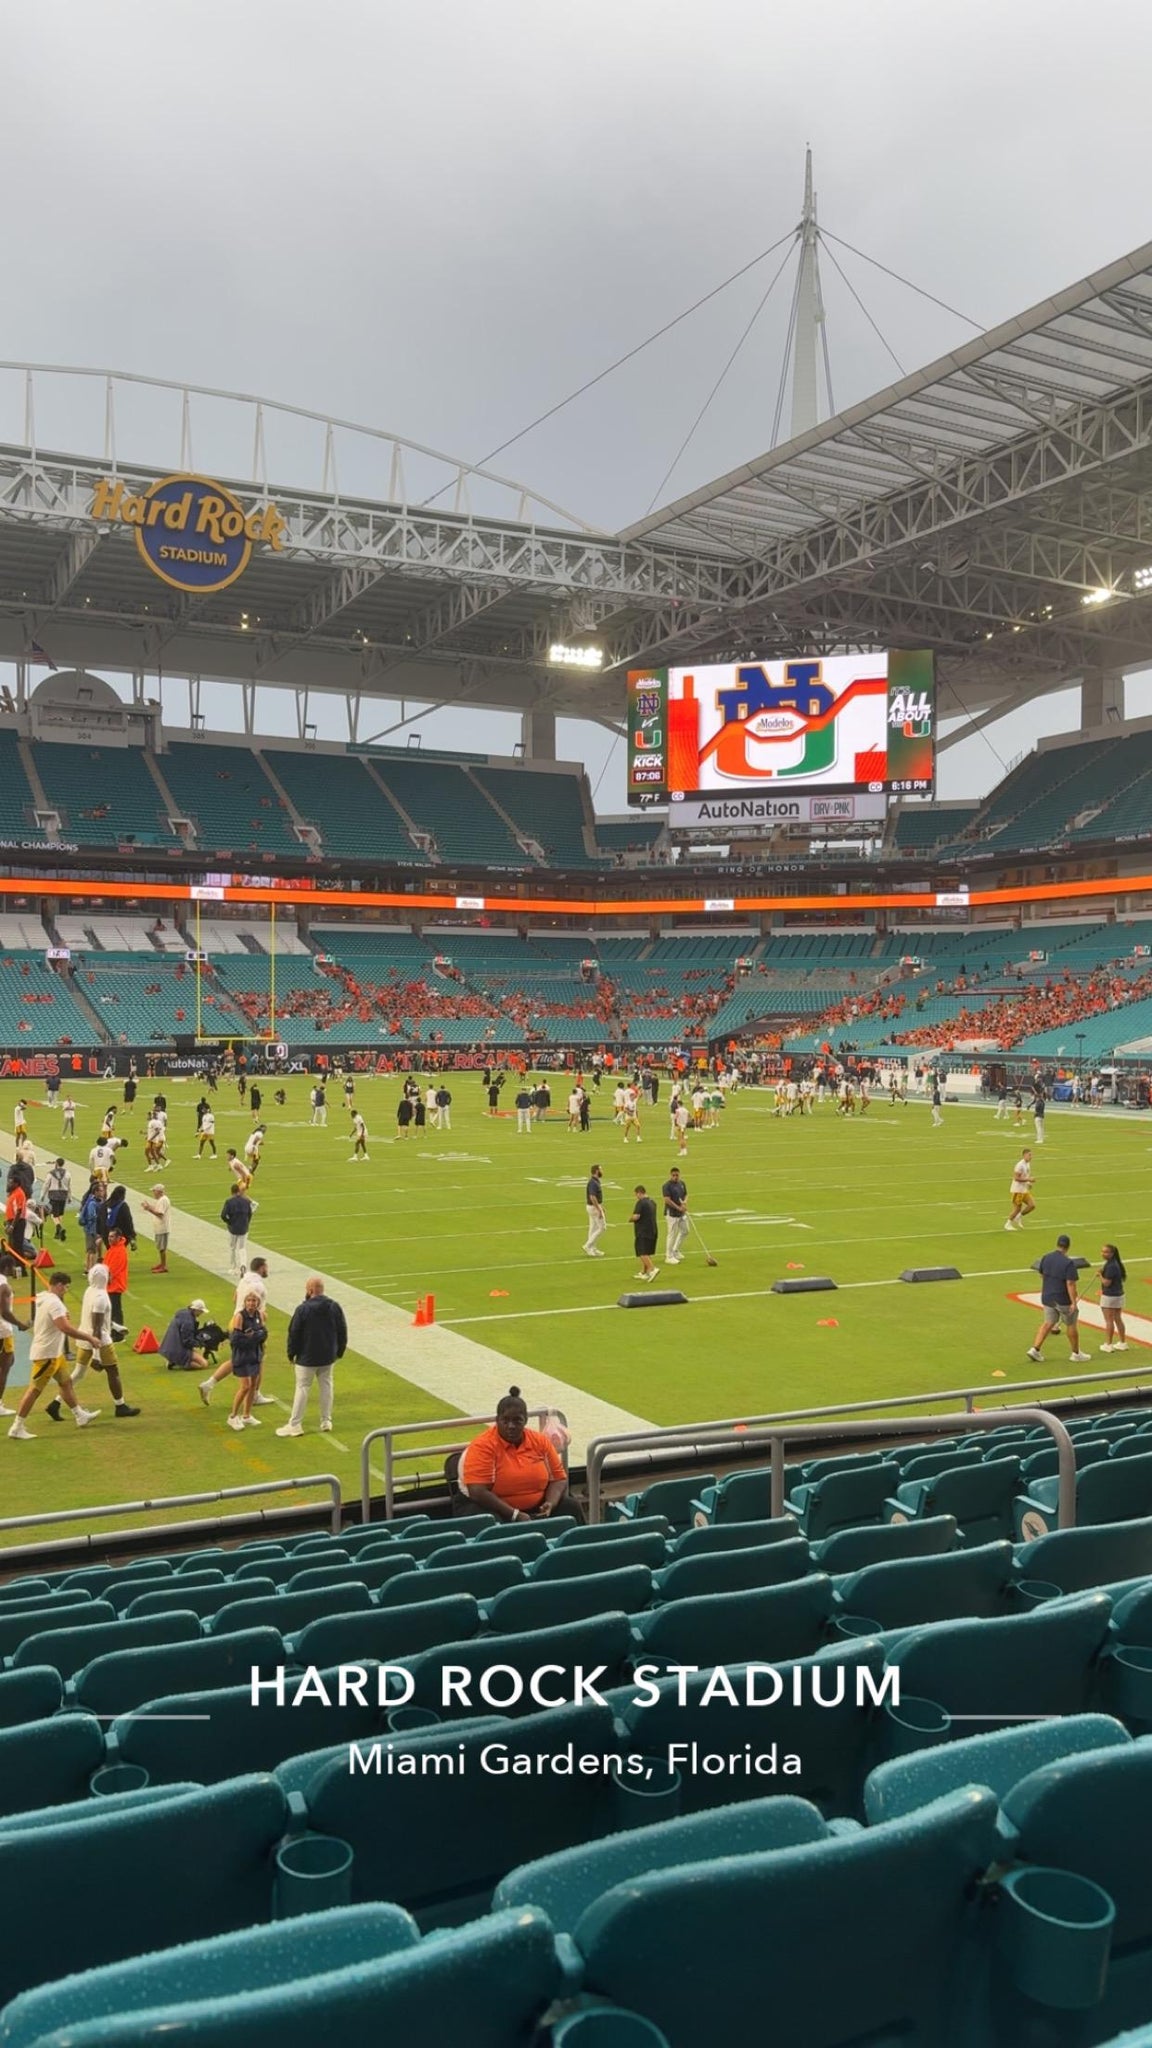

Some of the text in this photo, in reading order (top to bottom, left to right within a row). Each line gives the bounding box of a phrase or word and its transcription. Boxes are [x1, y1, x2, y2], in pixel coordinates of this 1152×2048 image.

[92, 479, 286, 551] Hard Rock
[160, 545, 228, 565] STADIUM
[889, 692, 931, 713] ALL
[888, 710, 931, 722] ABOUT
[634, 757, 663, 768] KICK
[914, 780, 927, 790] PM
[698, 801, 800, 819] AutoNation
[21, 841, 79, 852] CHAMPIONS
[749, 865, 762, 873] OF
[768, 864, 805, 873] HONOR
